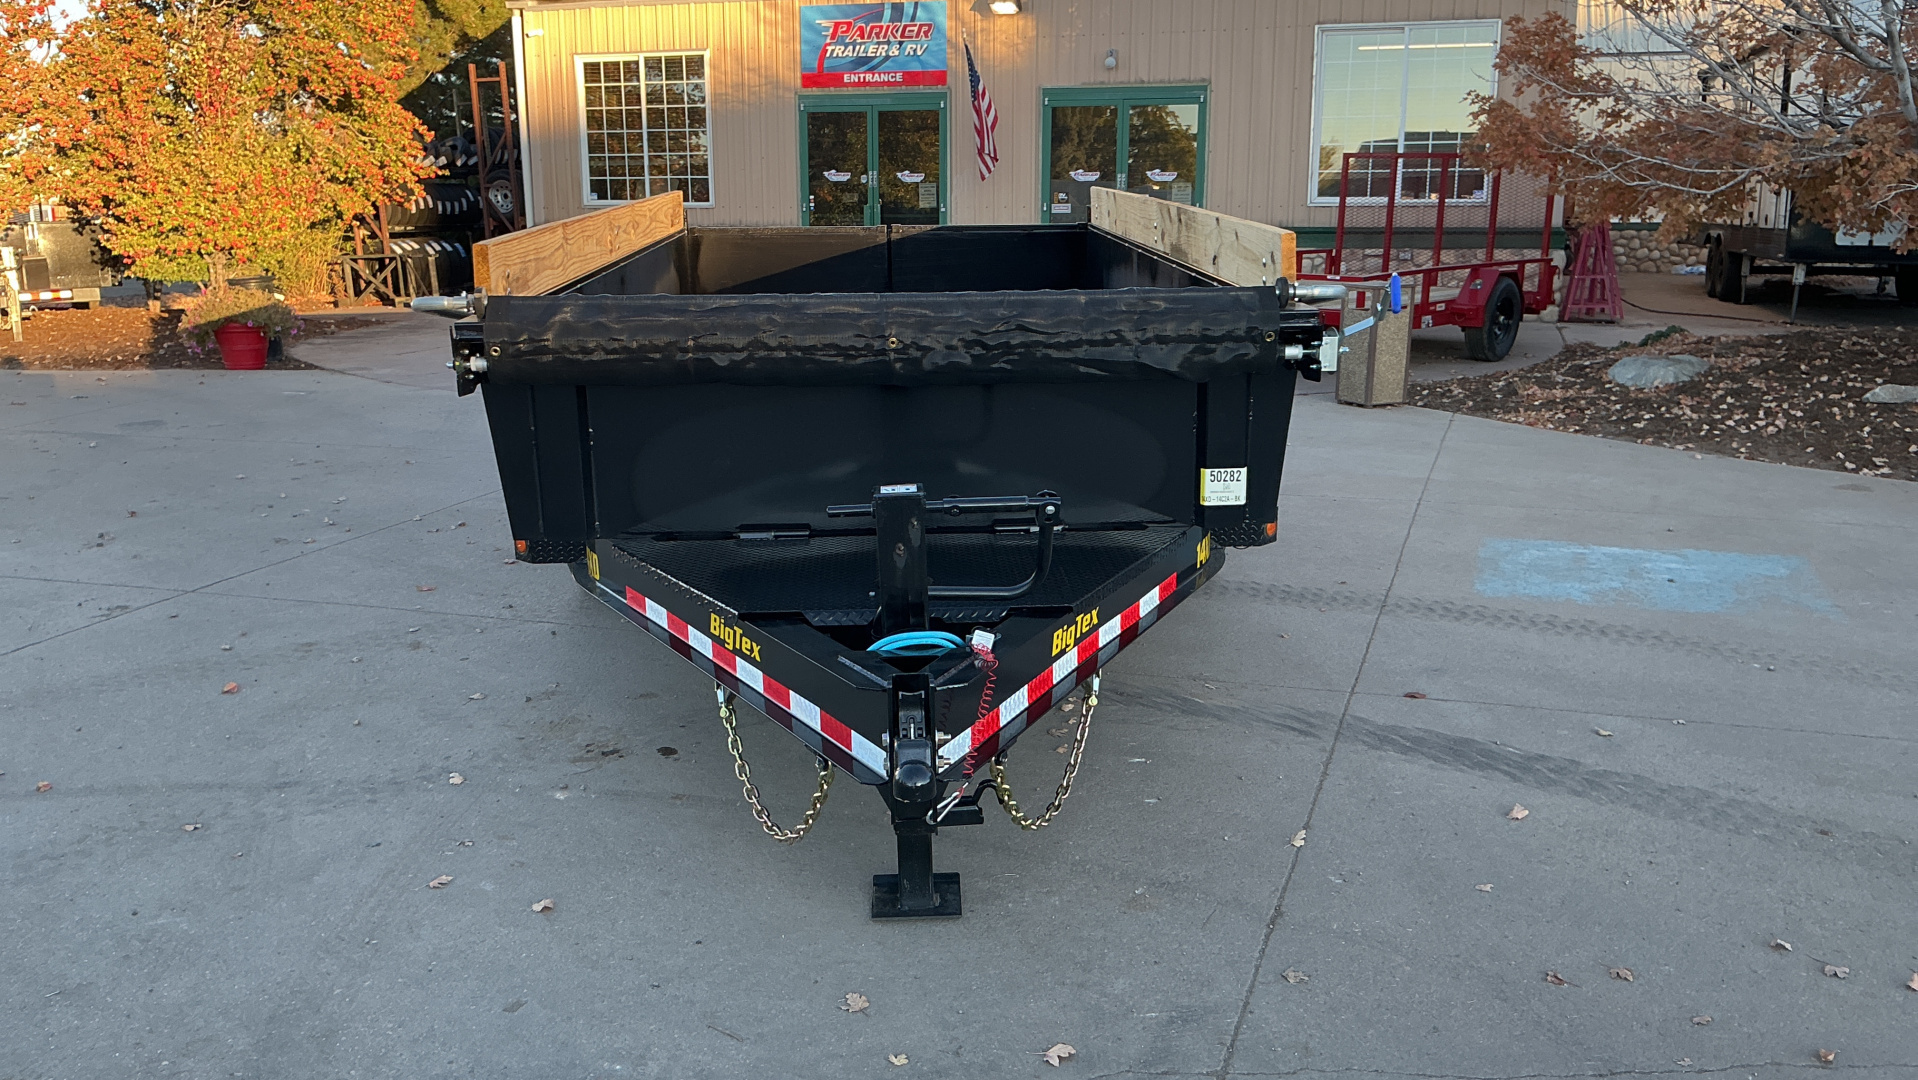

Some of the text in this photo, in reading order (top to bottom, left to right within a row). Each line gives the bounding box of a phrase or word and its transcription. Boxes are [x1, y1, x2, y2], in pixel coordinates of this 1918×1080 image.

[821, 20, 934, 43] PARKER
[826, 44, 928, 57] TRAILER & RV
[843, 72, 903, 83] ENTRANCE
[1209, 470, 1242, 483] 50282
[710, 612, 761, 662] BigTex
[1051, 606, 1099, 657] BigTex
